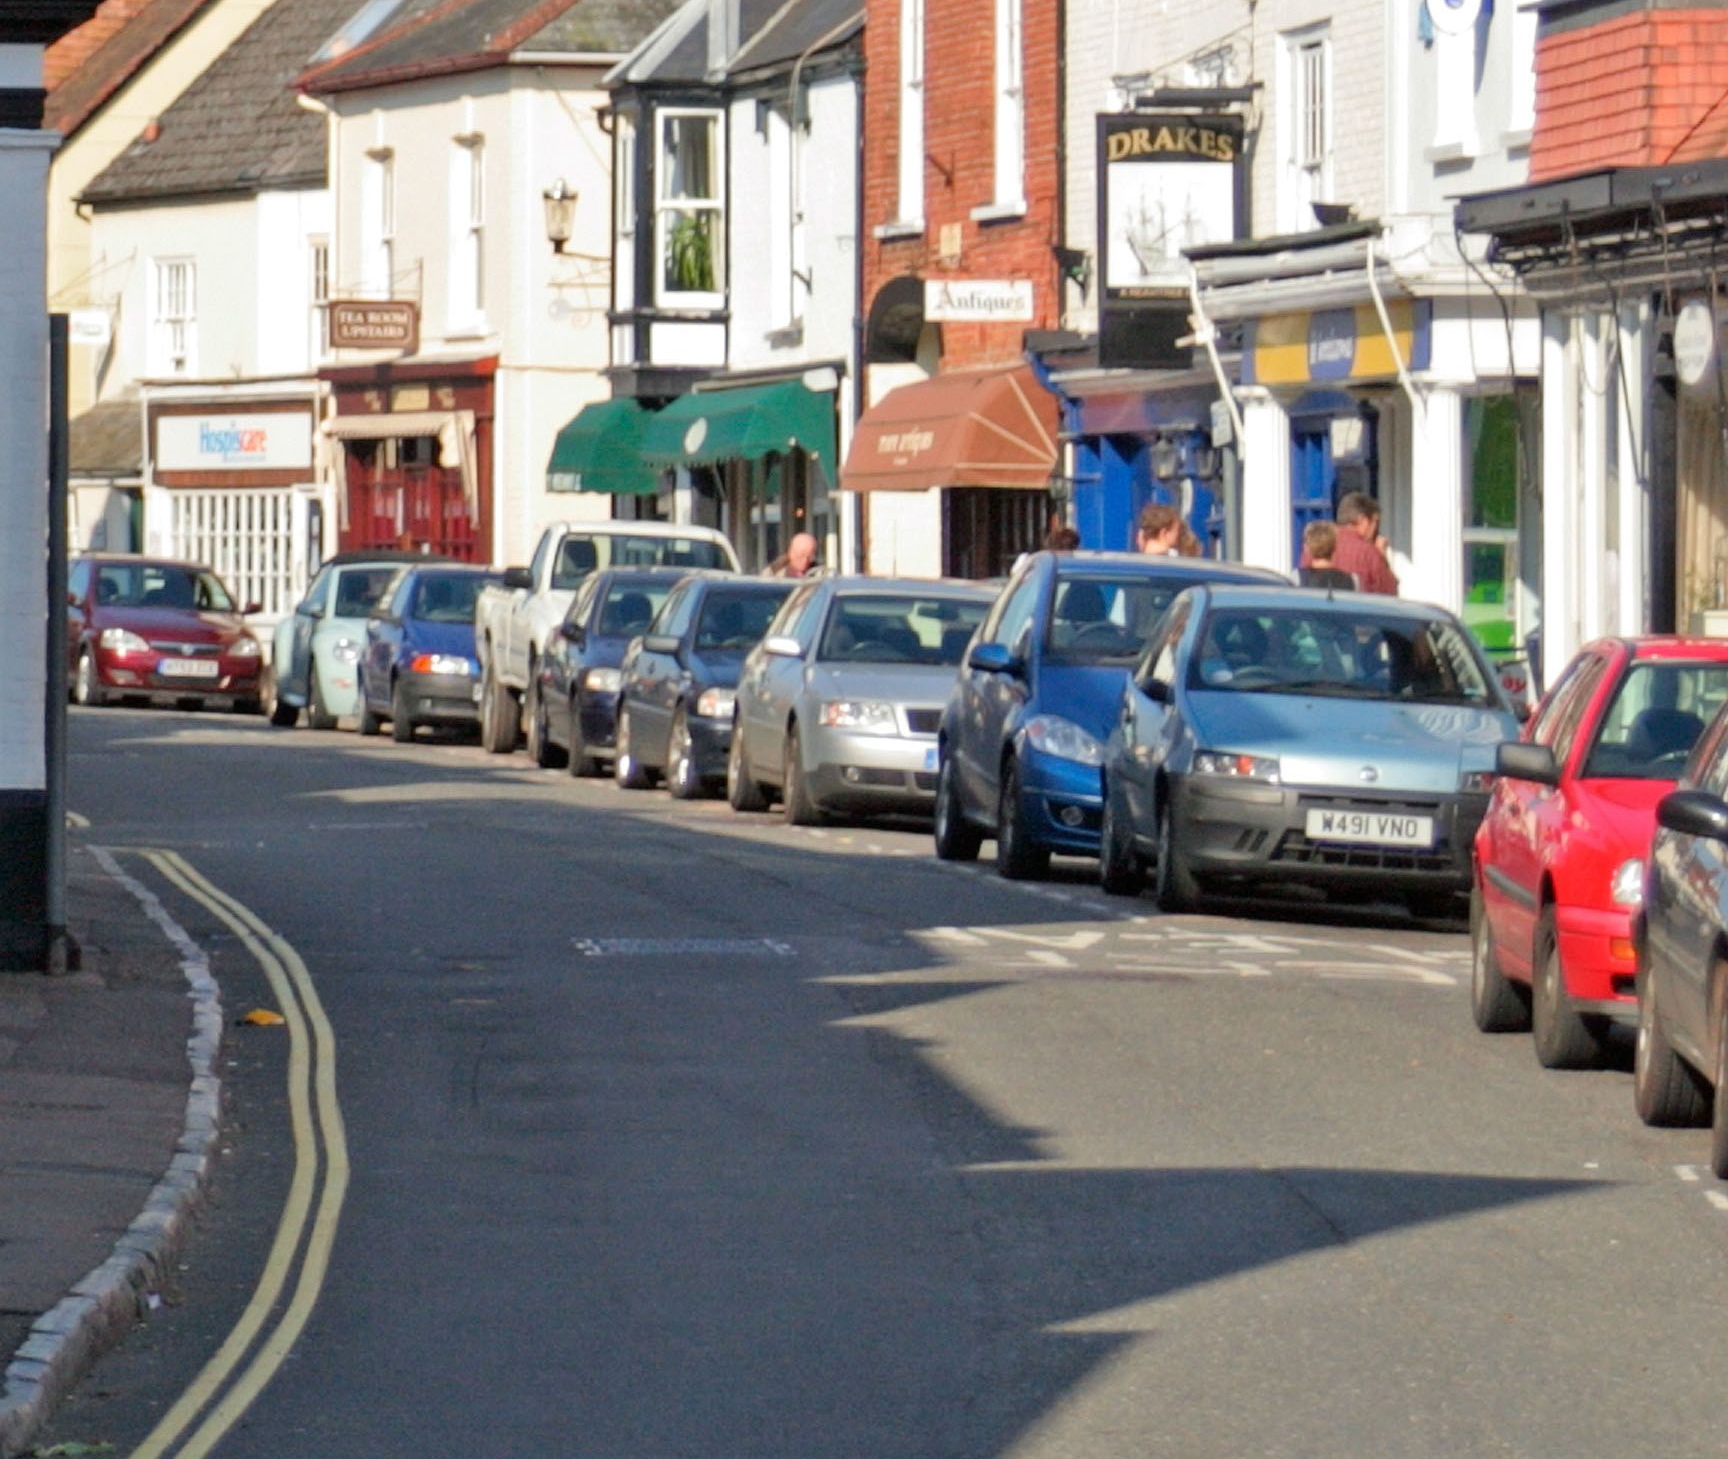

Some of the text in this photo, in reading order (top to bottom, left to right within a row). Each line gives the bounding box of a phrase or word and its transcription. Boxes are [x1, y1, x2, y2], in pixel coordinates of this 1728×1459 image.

[1107, 126, 1234, 161] DRAKES
[933, 280, 1025, 314] Antiques
[1322, 812, 1370, 835] W491
